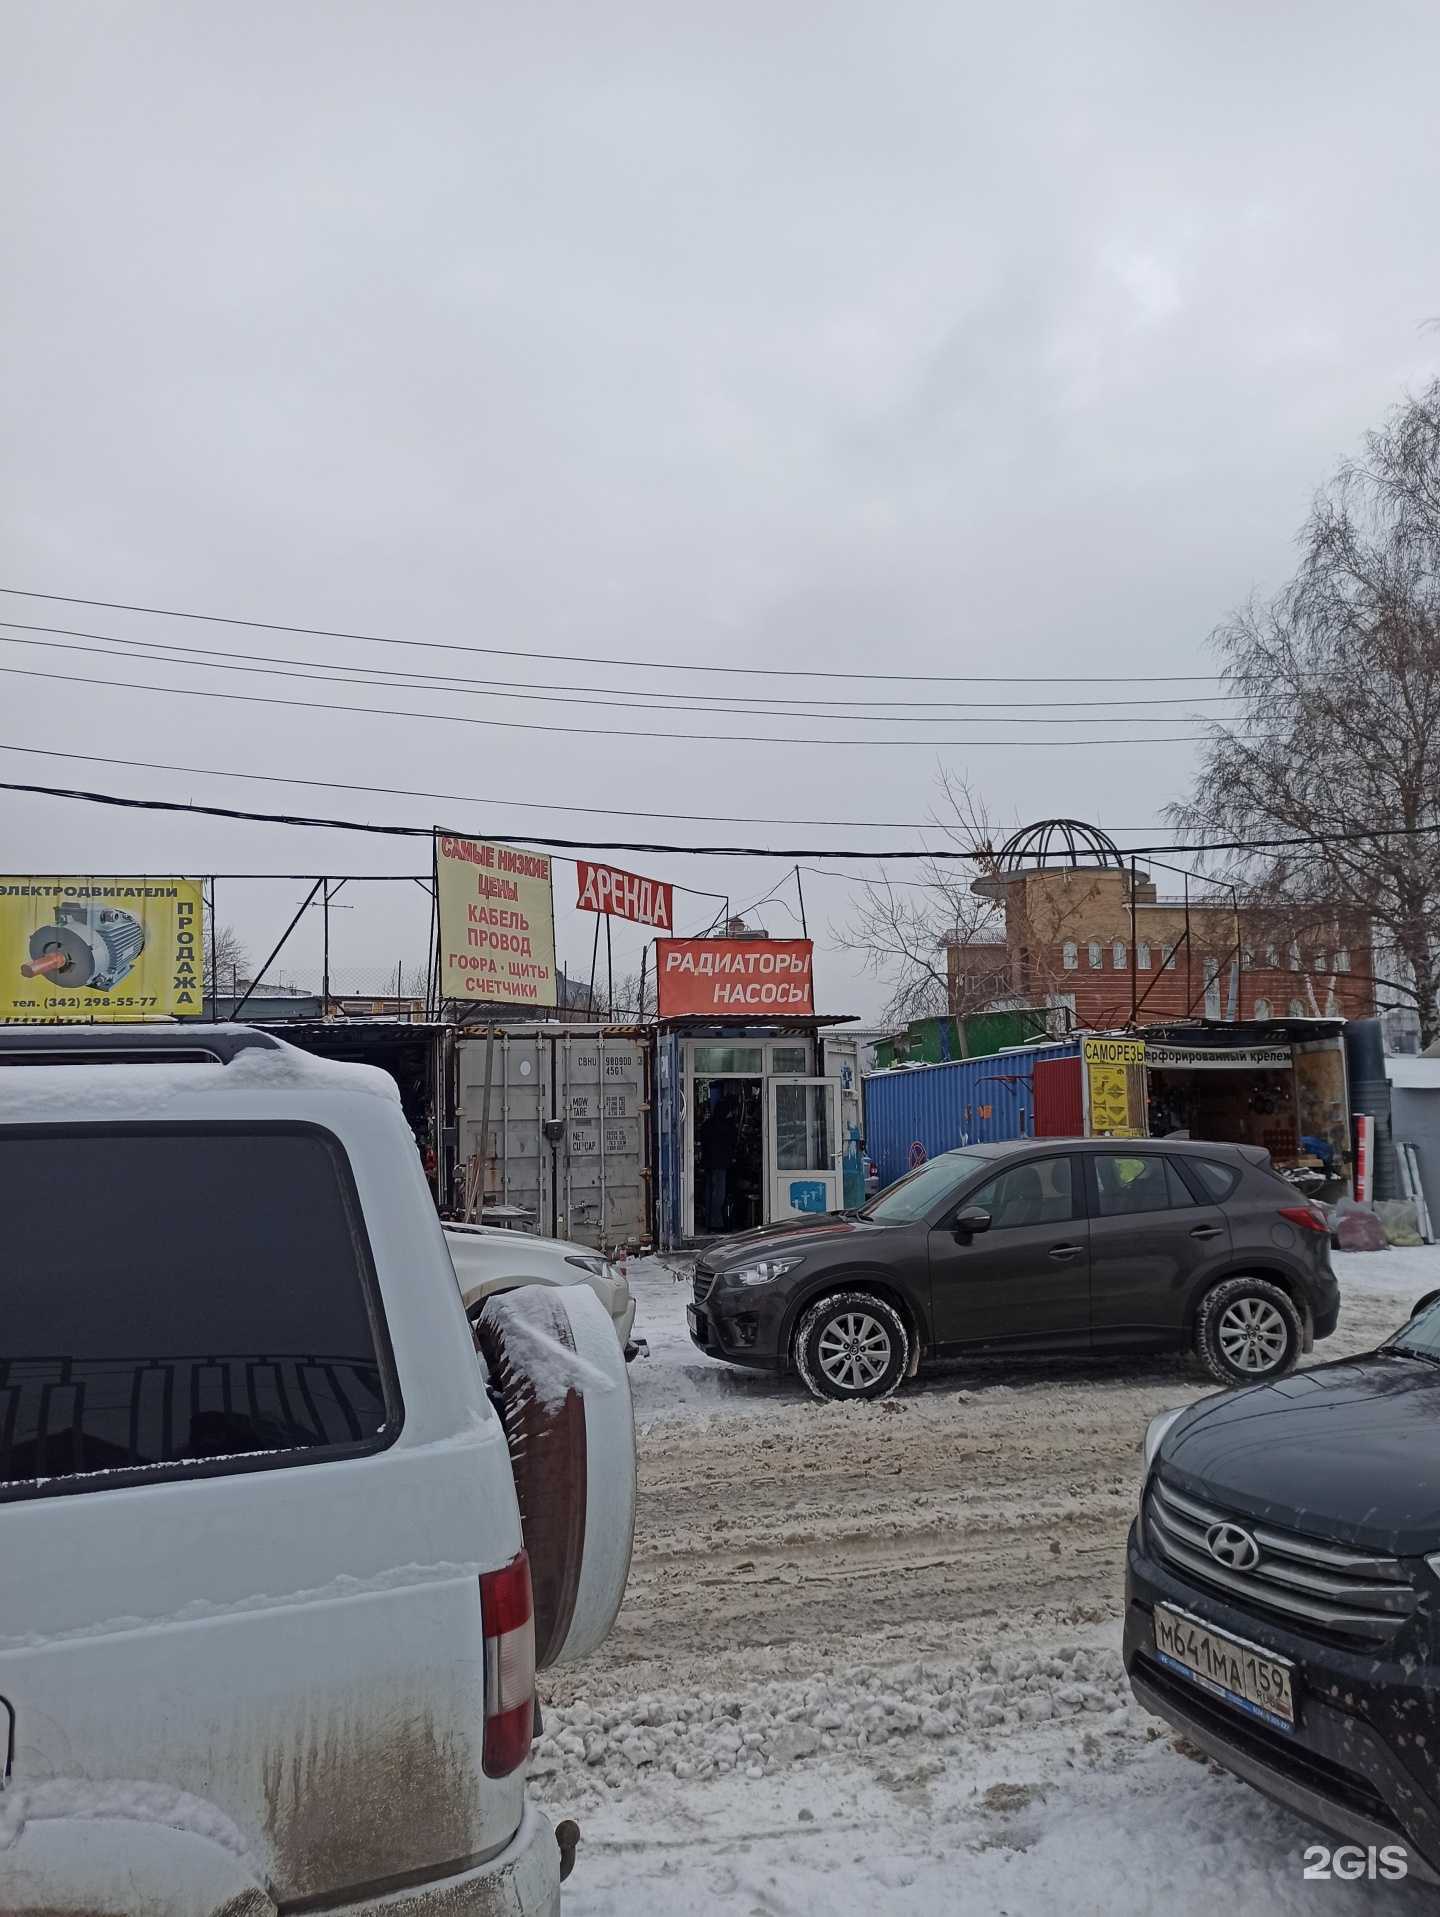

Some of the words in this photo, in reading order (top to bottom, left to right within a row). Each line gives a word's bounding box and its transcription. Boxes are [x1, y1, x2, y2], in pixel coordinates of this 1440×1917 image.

[441, 837, 494, 868] САМЫЕ
[498, 850, 549, 881] НИЗКИЕ
[0, 885, 178, 898] ЭЛЕКТРОДВИГАТЕЛИ
[478, 874, 518, 901] ЦЕНЫ
[578, 866, 668, 926] АРЕНДА
[468, 904, 529, 930] КАБЕЛЬ
[173, 902, 197, 1004] ПРОДАЖА
[467, 928, 531, 957] ПРОВОД
[449, 954, 497, 974] ГОФРА
[508, 964, 549, 980] ЩИТЫ
[666, 952, 810, 976] РАДИАТОРЫ
[465, 977, 537, 998] СЧЕТЧИКИ
[713, 983, 810, 1004] НАСОСЫ
[13, 999, 40, 1008] тел.
[44, 997, 80, 1009] (342)
[85, 997, 158, 1007] 298-55-77
[1085, 1043, 1147, 1062] САМОРЕЗЫ
[1145, 1047, 1247, 1064] ерфорированный
[1246, 1657, 1285, 1698] 159
